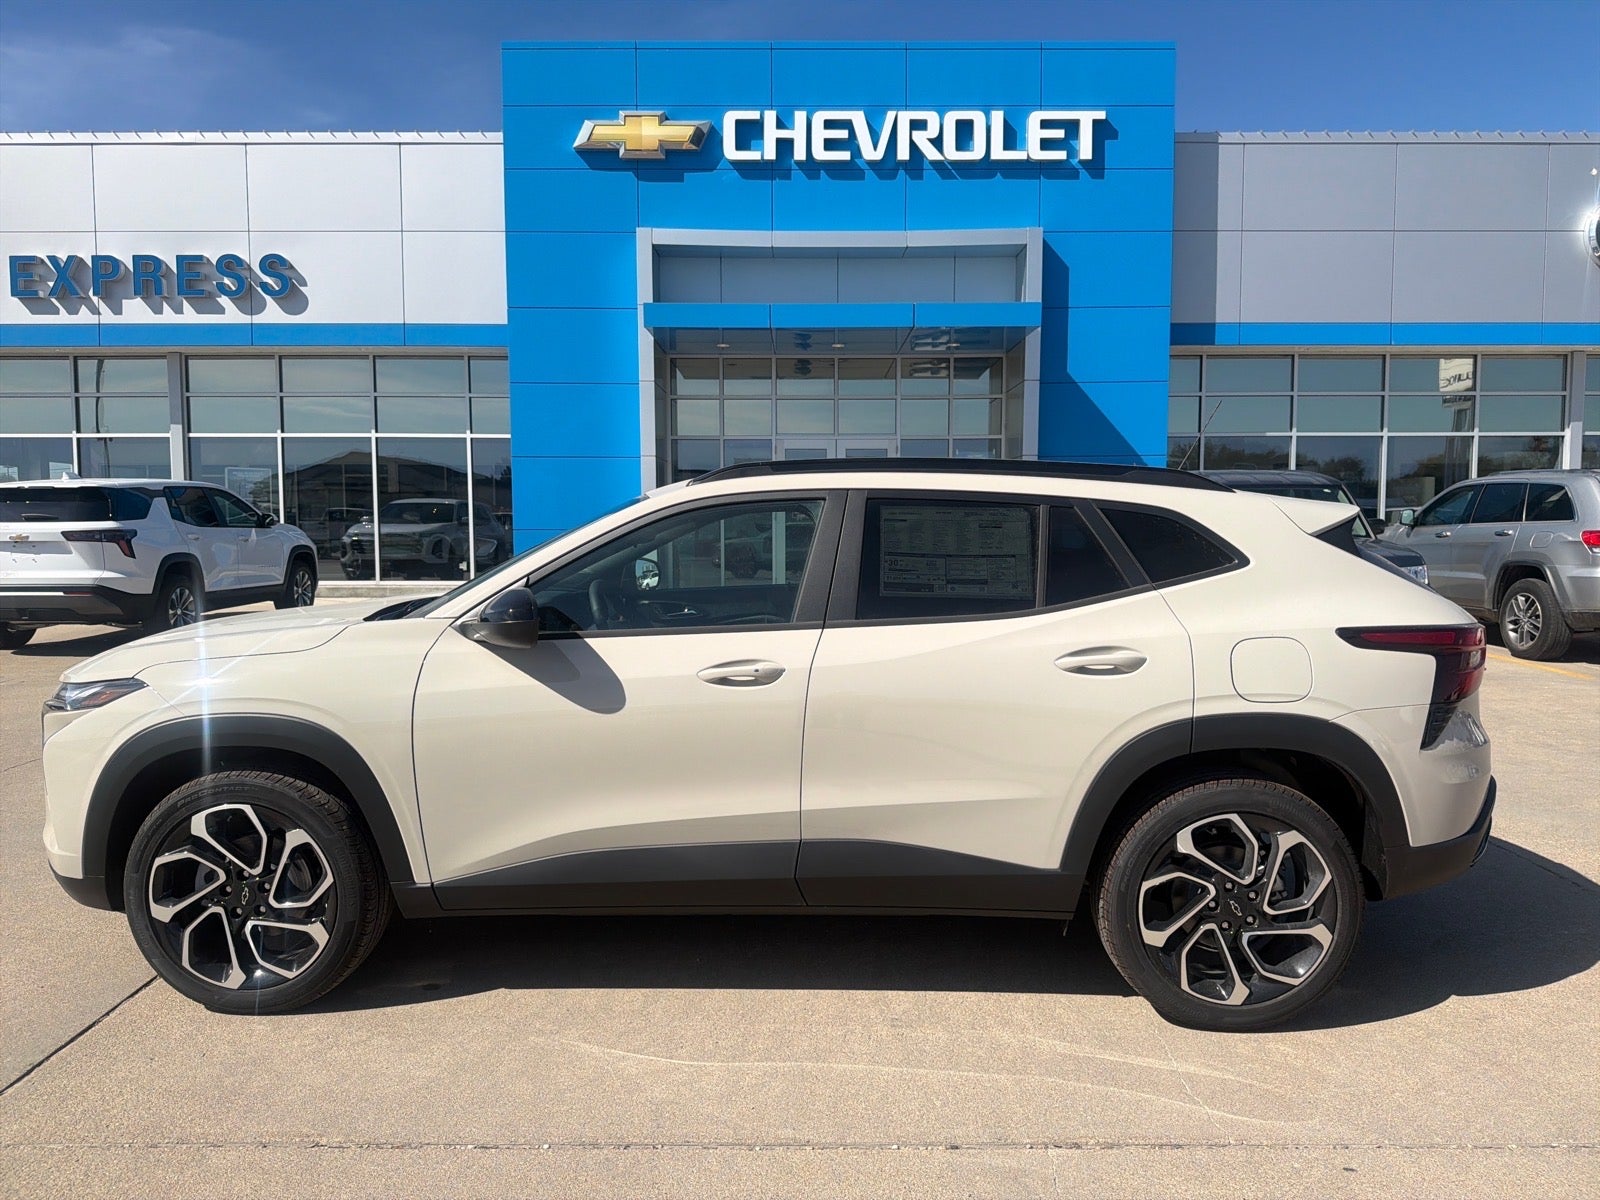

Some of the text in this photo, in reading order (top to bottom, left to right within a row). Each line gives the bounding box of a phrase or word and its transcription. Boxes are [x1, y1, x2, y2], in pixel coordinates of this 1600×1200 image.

[722, 110, 1107, 161] CHEVROLET
[9, 253, 293, 299] EXPRESS
[888, 559, 899, 567] 30
